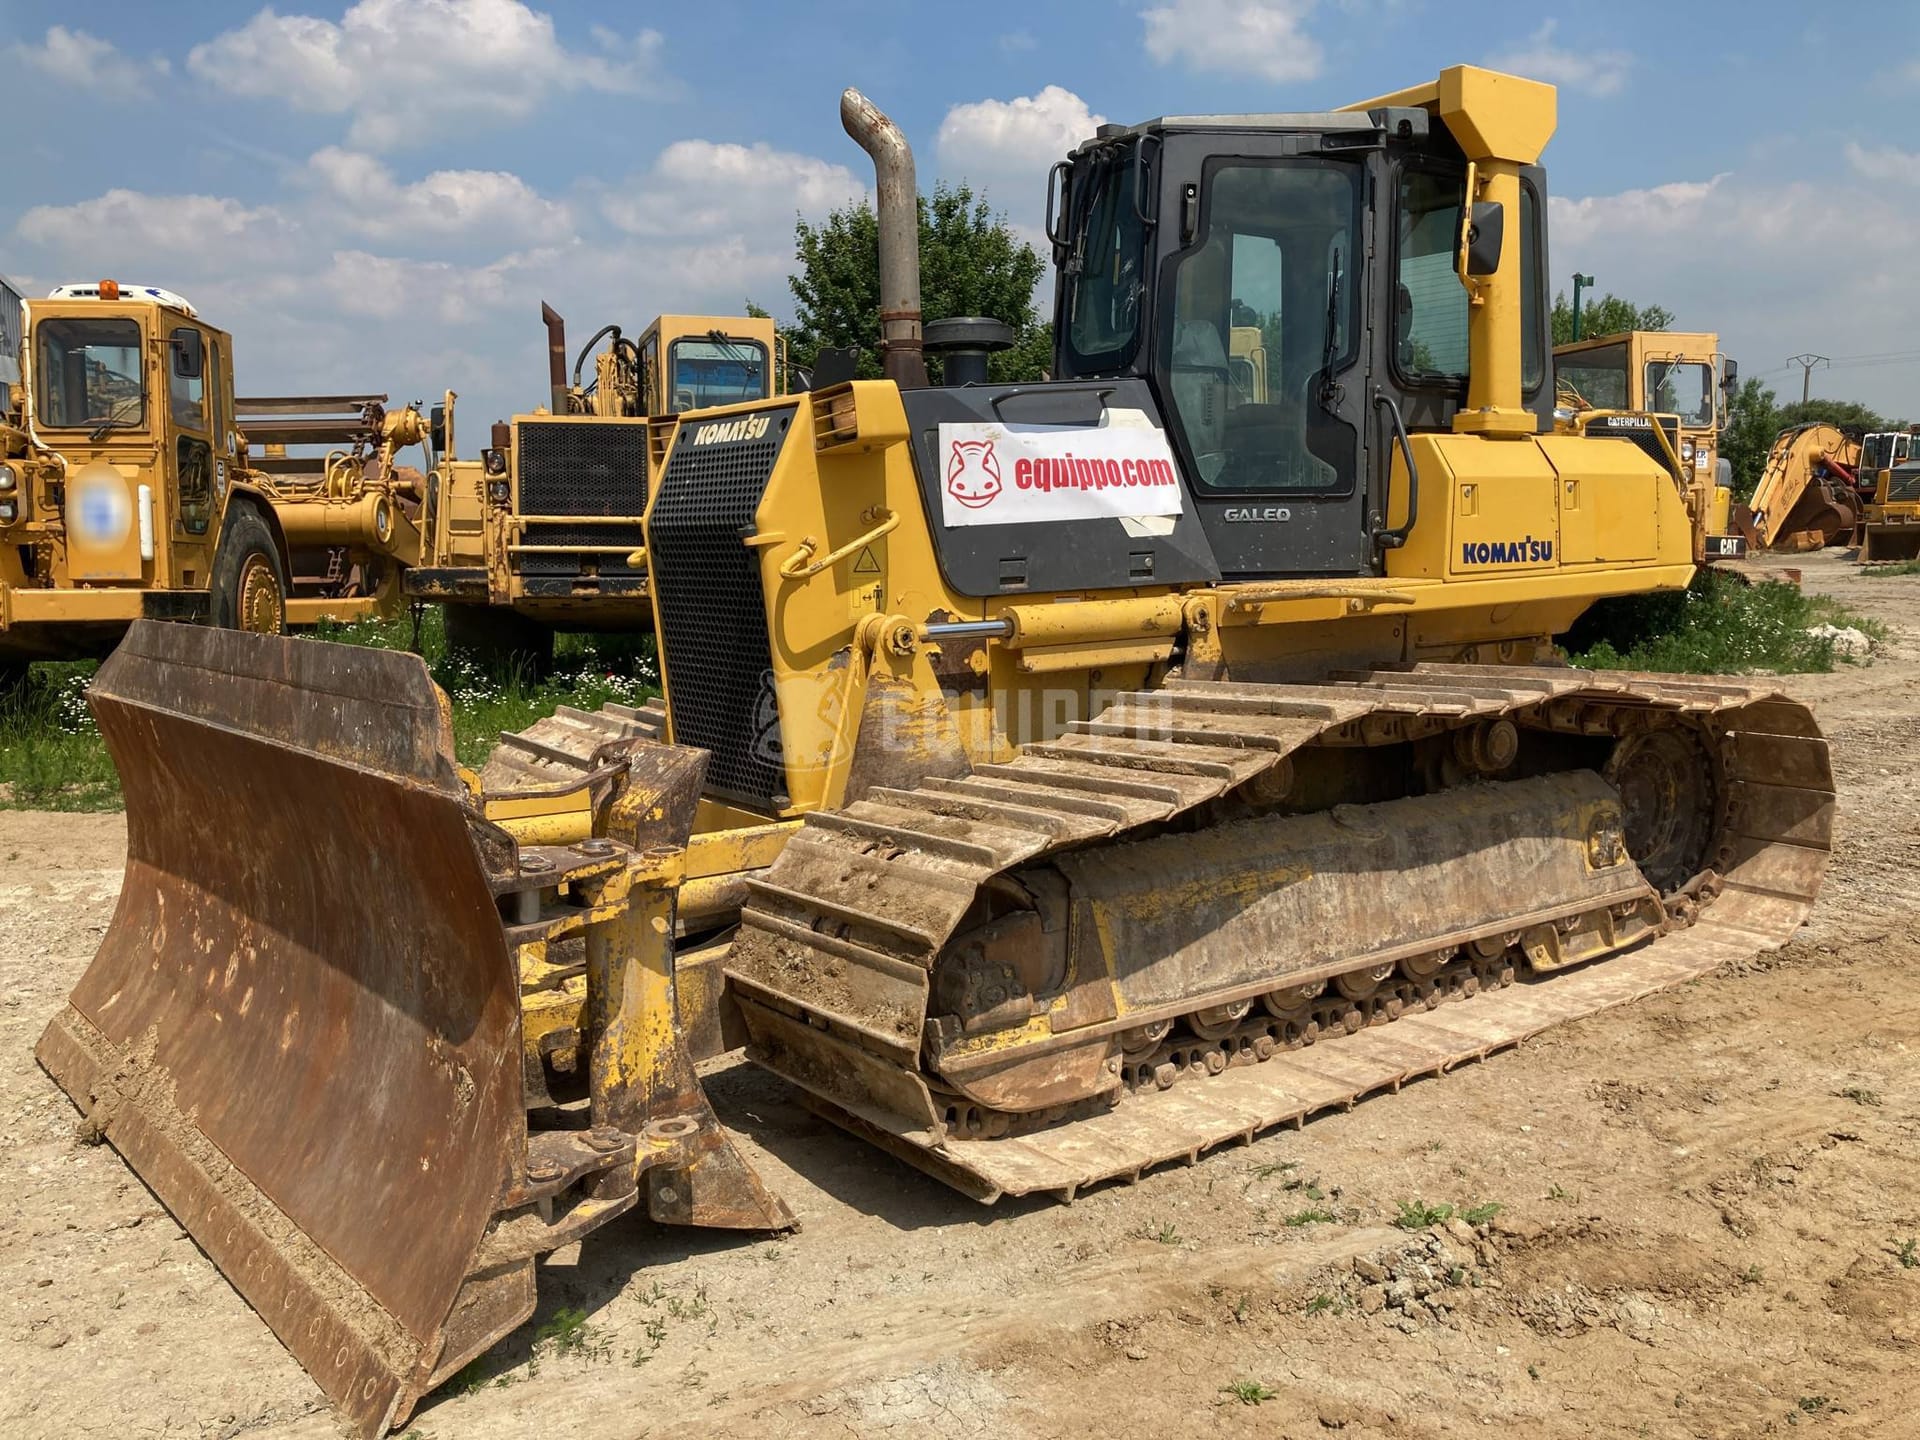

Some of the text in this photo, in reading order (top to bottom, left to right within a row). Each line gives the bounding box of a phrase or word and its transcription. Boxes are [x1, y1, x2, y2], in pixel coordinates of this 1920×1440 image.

[693, 413, 770, 446] KOMATSU
[1015, 452, 1175, 492] equippo.com
[1224, 508, 1291, 522] GALEO
[1462, 535, 1553, 564] KOMATSU
[1720, 538, 1738, 555] CAT
